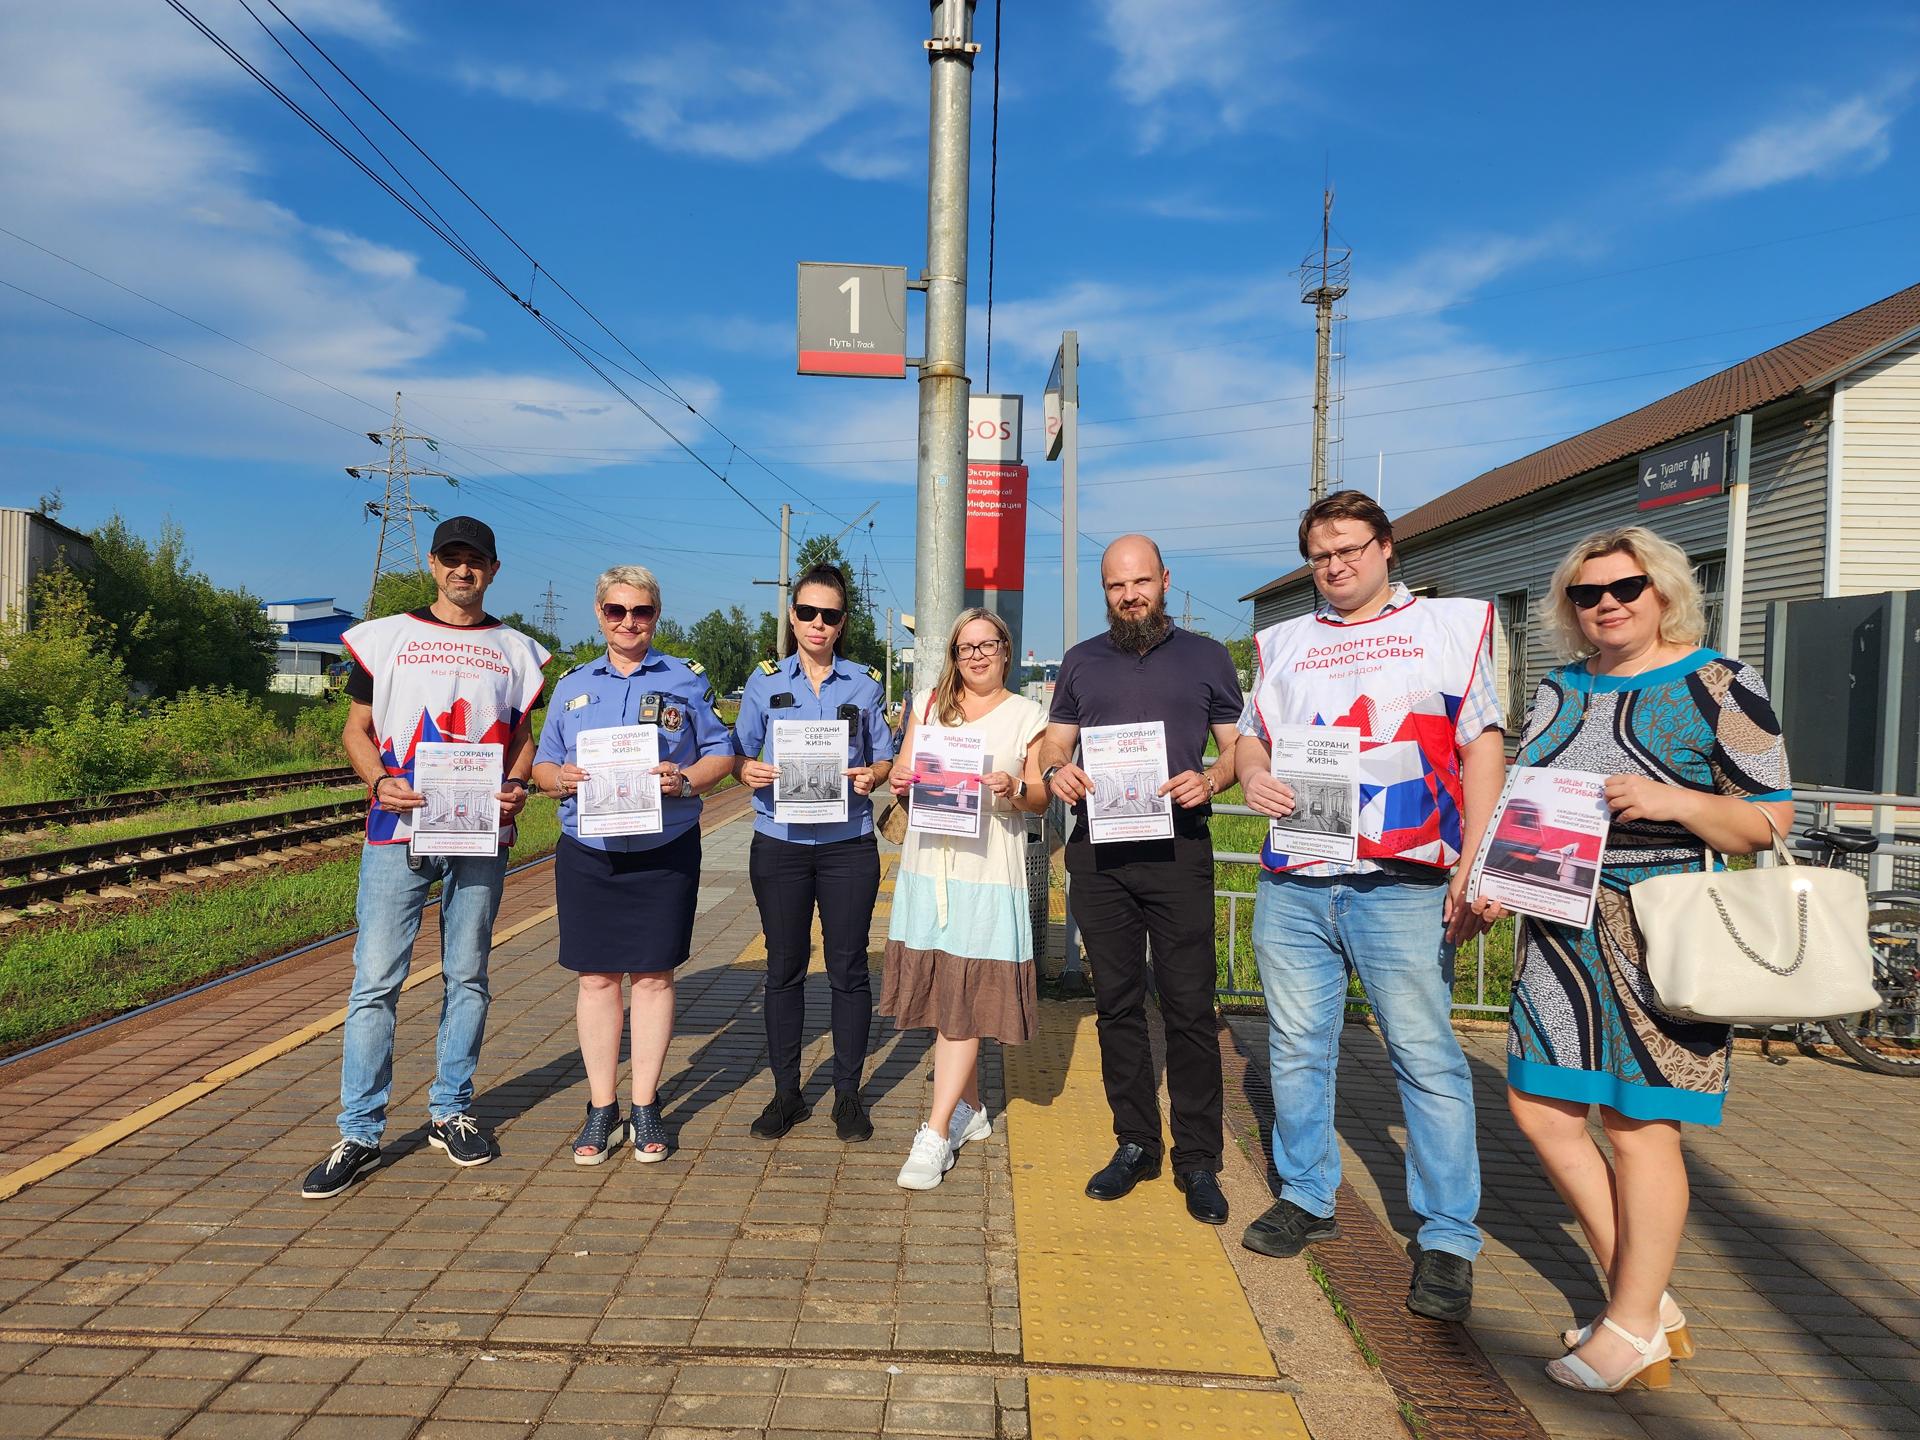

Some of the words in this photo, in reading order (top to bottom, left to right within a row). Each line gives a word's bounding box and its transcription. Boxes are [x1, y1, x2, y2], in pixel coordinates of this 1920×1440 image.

[838, 277, 859, 333] 1
[829, 338, 851, 349] Путь
[857, 340, 874, 349] Track
[968, 468, 1018, 478] Экстренный
[1661, 460, 1688, 478] Туалет
[1660, 479, 1677, 491] Toilet
[968, 488, 1000, 496] Emergency
[967, 500, 1021, 509] Информация
[408, 641, 502, 660] ВОЛОНТЕРЫ
[1307, 635, 1412, 658] ВОЛОНТЕРЫ
[397, 654, 510, 675] ПОДМОСКОВЬЯ
[1294, 648, 1424, 672] ПОДМОСКОВЬЯ
[449, 670, 480, 679] РЯДОМ
[1348, 666, 1382, 676] РЯДОМ
[612, 732, 649, 740] СОХРАНИ
[1117, 730, 1156, 738] СОХРАНИ
[1307, 740, 1349, 749] СОХРАНИ
[1307, 748, 1328, 756] СЕБЕ
[1307, 757, 1338, 765] ЖИЗНЬ
[1553, 777, 1583, 786] ЗАЙЦЫ
[1585, 782, 1604, 790] ТОЖ
[1558, 786, 1603, 798] ПОГИБАЮ
